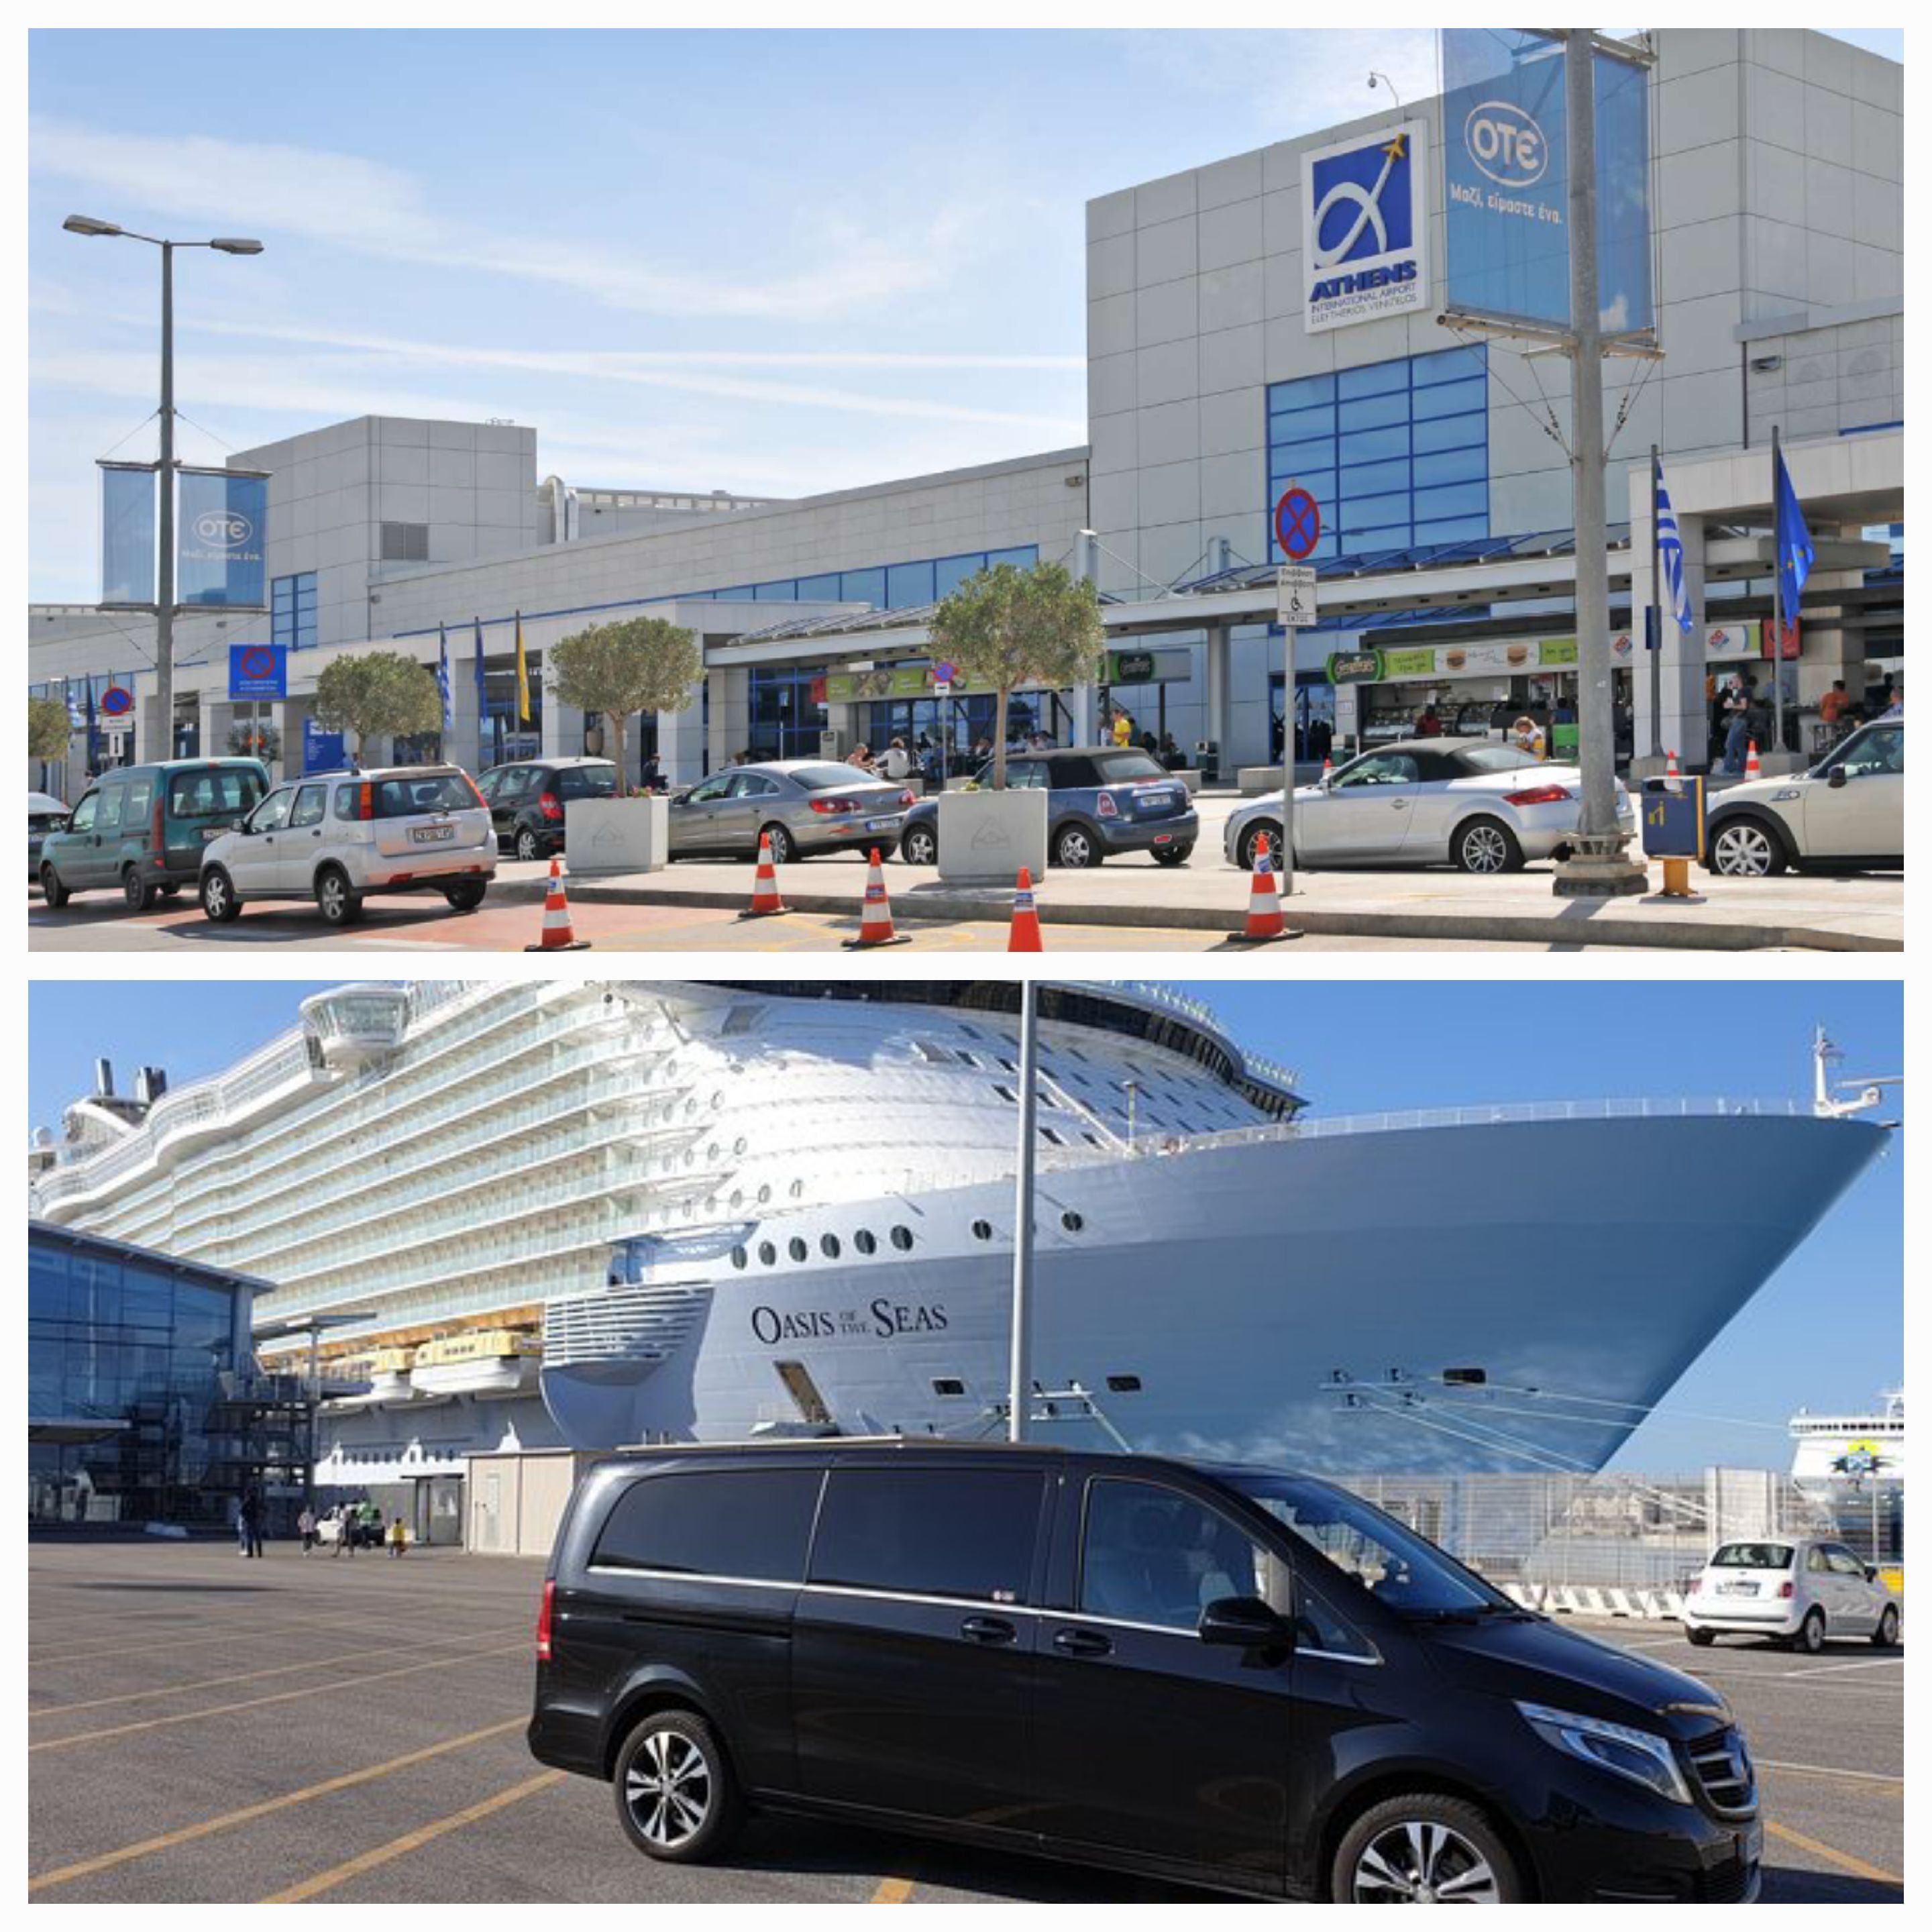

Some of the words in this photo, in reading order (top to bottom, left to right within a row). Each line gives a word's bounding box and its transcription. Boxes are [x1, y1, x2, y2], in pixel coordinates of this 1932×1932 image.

[1309, 259, 1417, 302] ATHENS
[1311, 292, 1377, 314] INTERNATIONAL
[1379, 282, 1416, 298] AIRPORT
[1311, 306, 1366, 325] ELEFTHERIOS
[870, 1297, 949, 1338] SEAS
